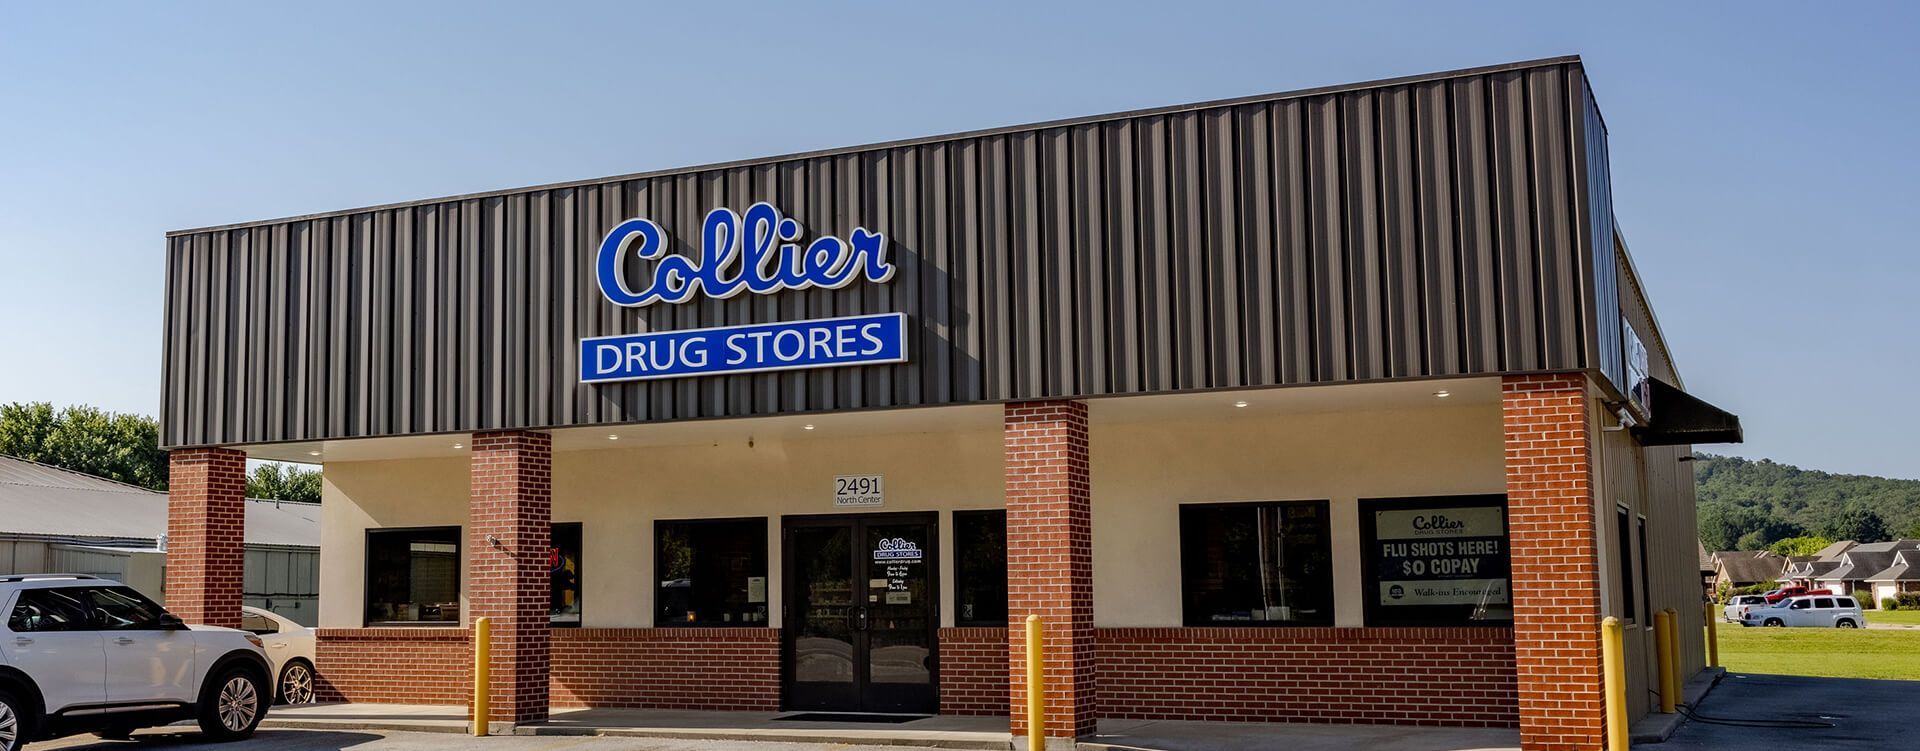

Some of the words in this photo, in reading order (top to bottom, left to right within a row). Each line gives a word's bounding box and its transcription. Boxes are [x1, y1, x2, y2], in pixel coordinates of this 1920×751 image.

[596, 202, 895, 307] Collier
[596, 337, 708, 375] DRUG
[726, 323, 883, 365] STORES
[837, 478, 880, 495] 2491
[837, 496, 857, 504] North
[858, 495, 881, 504] Center
[1413, 516, 1464, 530] Collier
[879, 538, 916, 551] Collier
[1383, 543, 1408, 558] FLU
[1411, 541, 1455, 557] SHOTS
[1458, 540, 1499, 555] HERE!
[1431, 558, 1480, 574] COPAY
[1414, 587, 1450, 597] Walk-ins
